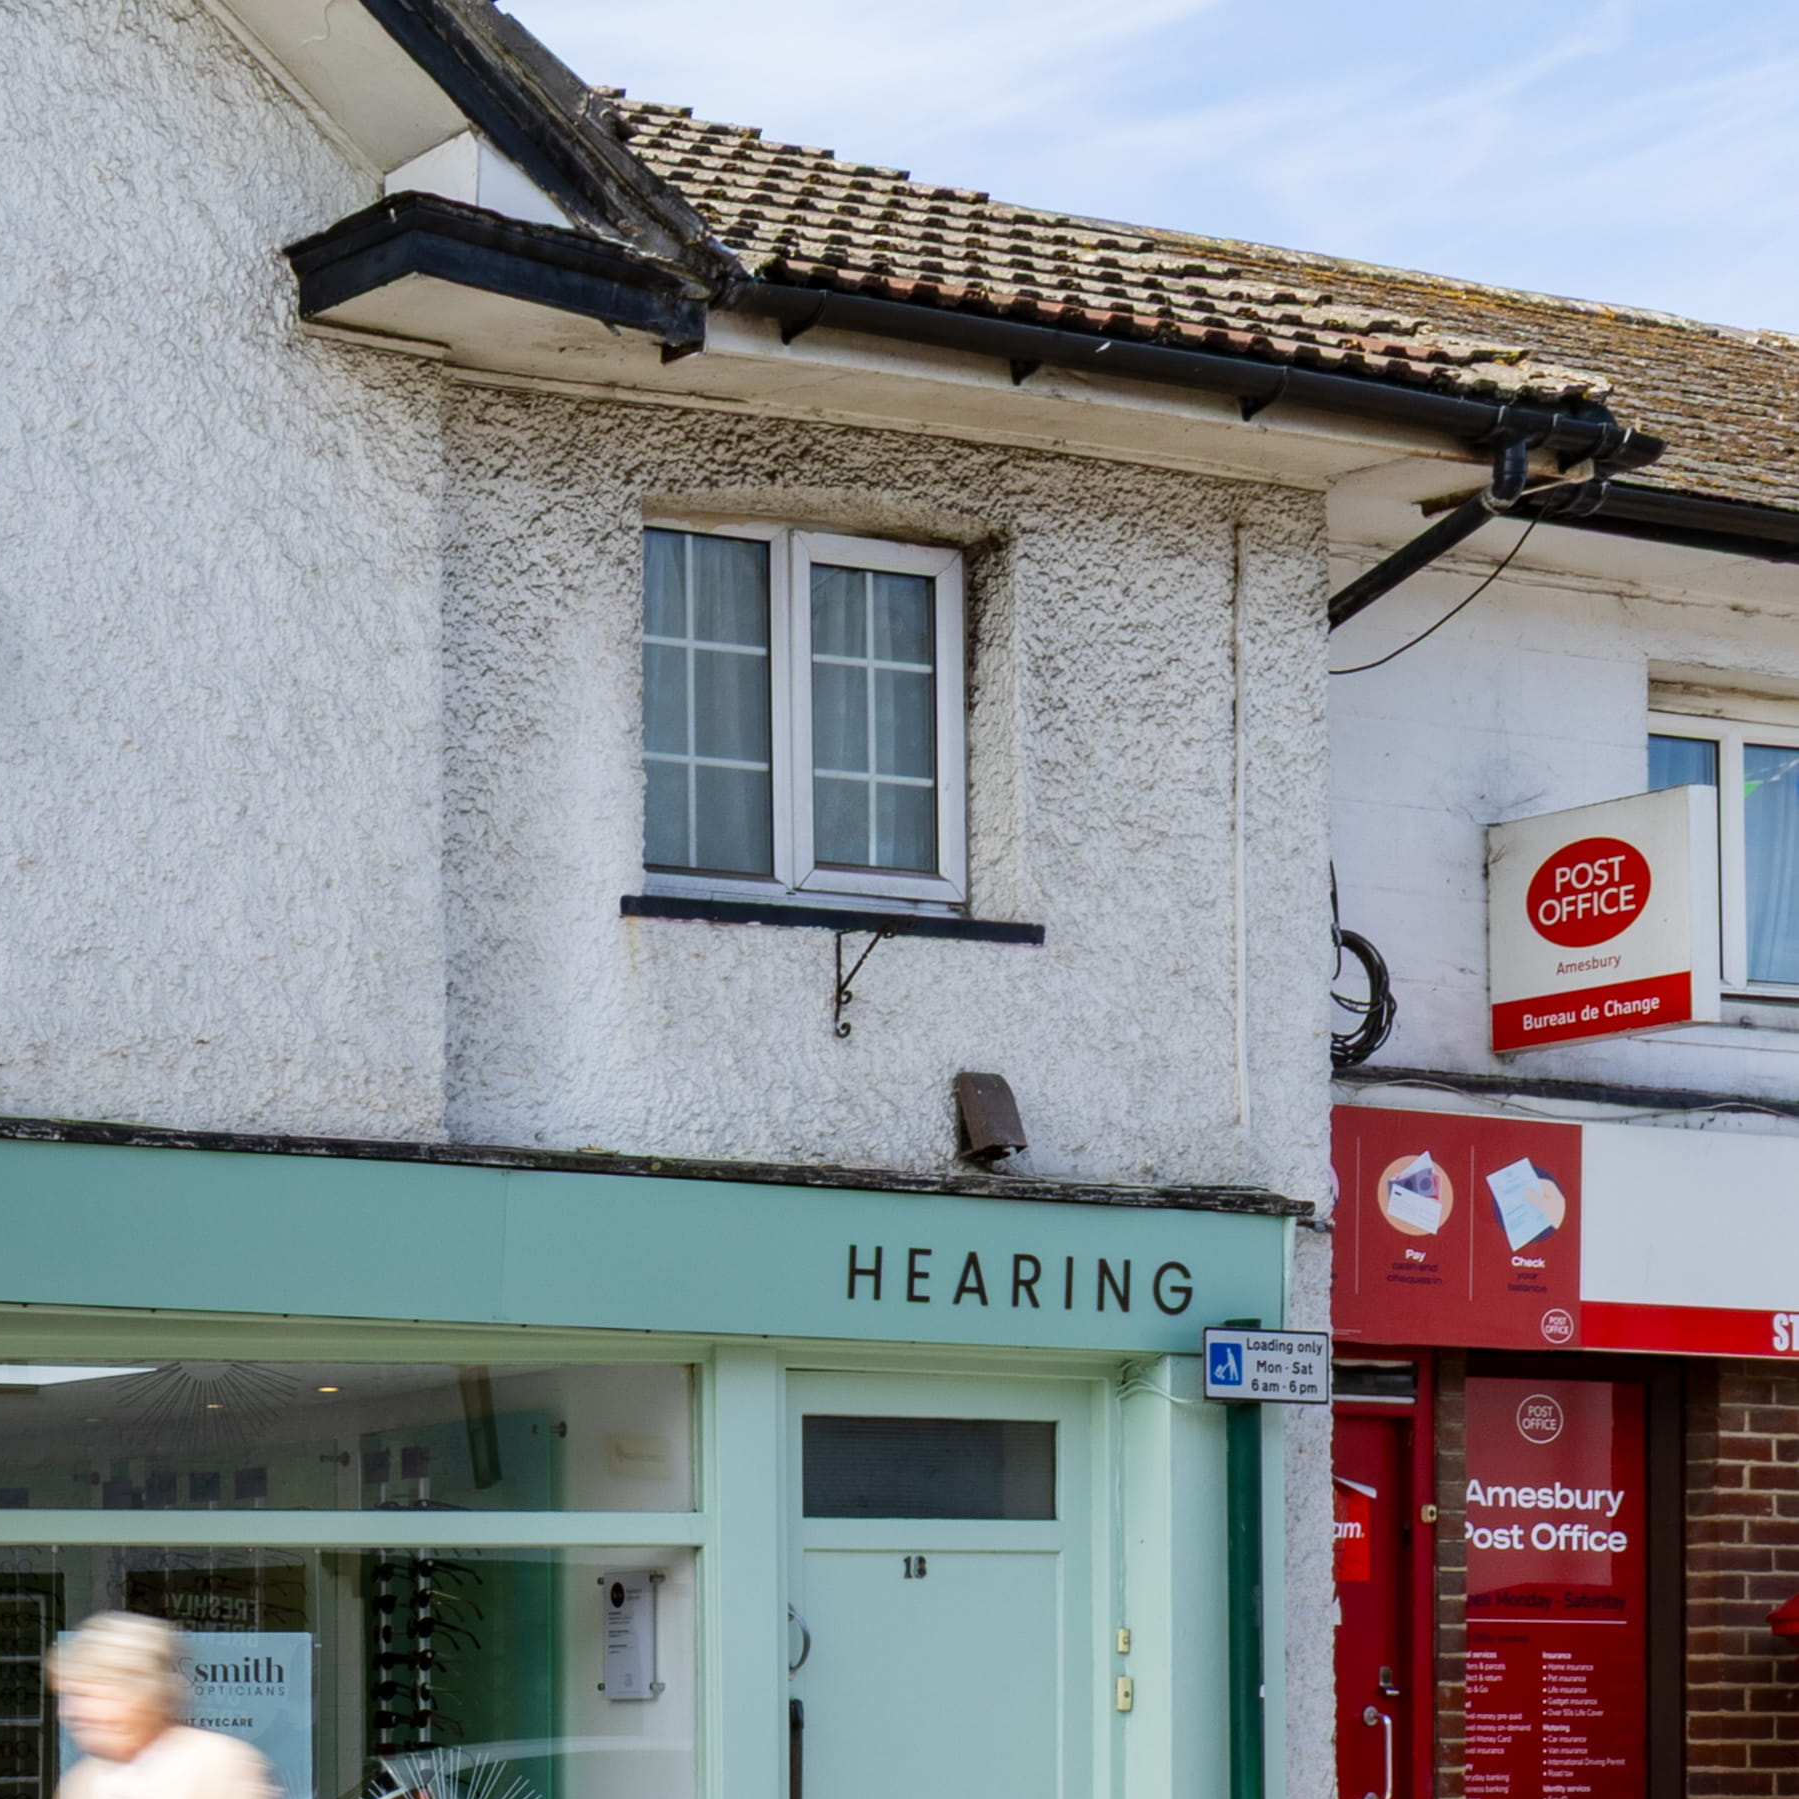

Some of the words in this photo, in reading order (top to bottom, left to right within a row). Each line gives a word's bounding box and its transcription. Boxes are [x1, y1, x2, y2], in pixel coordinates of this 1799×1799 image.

[1554, 855, 1626, 894] POST
[1537, 884, 1637, 928] OFFICE
[1555, 953, 1623, 977] Amesbury
[1523, 1006, 1577, 1031] Bureau
[1581, 1003, 1599, 1022] de
[1603, 994, 1661, 1019] Change
[1405, 1249, 1427, 1263] Pay
[1511, 1256, 1547, 1268] Check
[847, 1244, 1193, 1316] HEARING
[1549, 1316, 1567, 1325] POST
[1545, 1324, 1569, 1335] OFFICE
[1247, 1337, 1294, 1355] Loading
[1297, 1340, 1323, 1356] only
[1256, 1359, 1282, 1374] Mon
[1292, 1361, 1313, 1375] Sat
[1251, 1378, 1259, 1392] 6
[1262, 1382, 1280, 1392] am
[1289, 1380, 1297, 1393] 6
[1299, 1384, 1318, 1395] pm
[1528, 1405, 1554, 1417] POST
[1522, 1417, 1557, 1431] OFFICE
[1465, 1478, 1625, 1518] Amesbury
[1530, 1521, 1627, 1553] Office
[1495, 1591, 1552, 1611] Monday
[1563, 1591, 1626, 1612] Saturday
[1542, 1651, 1572, 1660] Insurance
[193, 1686, 285, 1697] OPTICIANS
[1559, 1686, 1588, 1694] insurance
[1570, 1698, 1598, 1706] insurance
[1547, 1708, 1562, 1717] Over
[1586, 1708, 1604, 1717] Cover
[201, 1717, 255, 1728] EYECARE
[1542, 1723, 1570, 1733] Motoring
[1560, 1747, 1588, 1755] insurance
[1566, 1784, 1592, 1793] services
